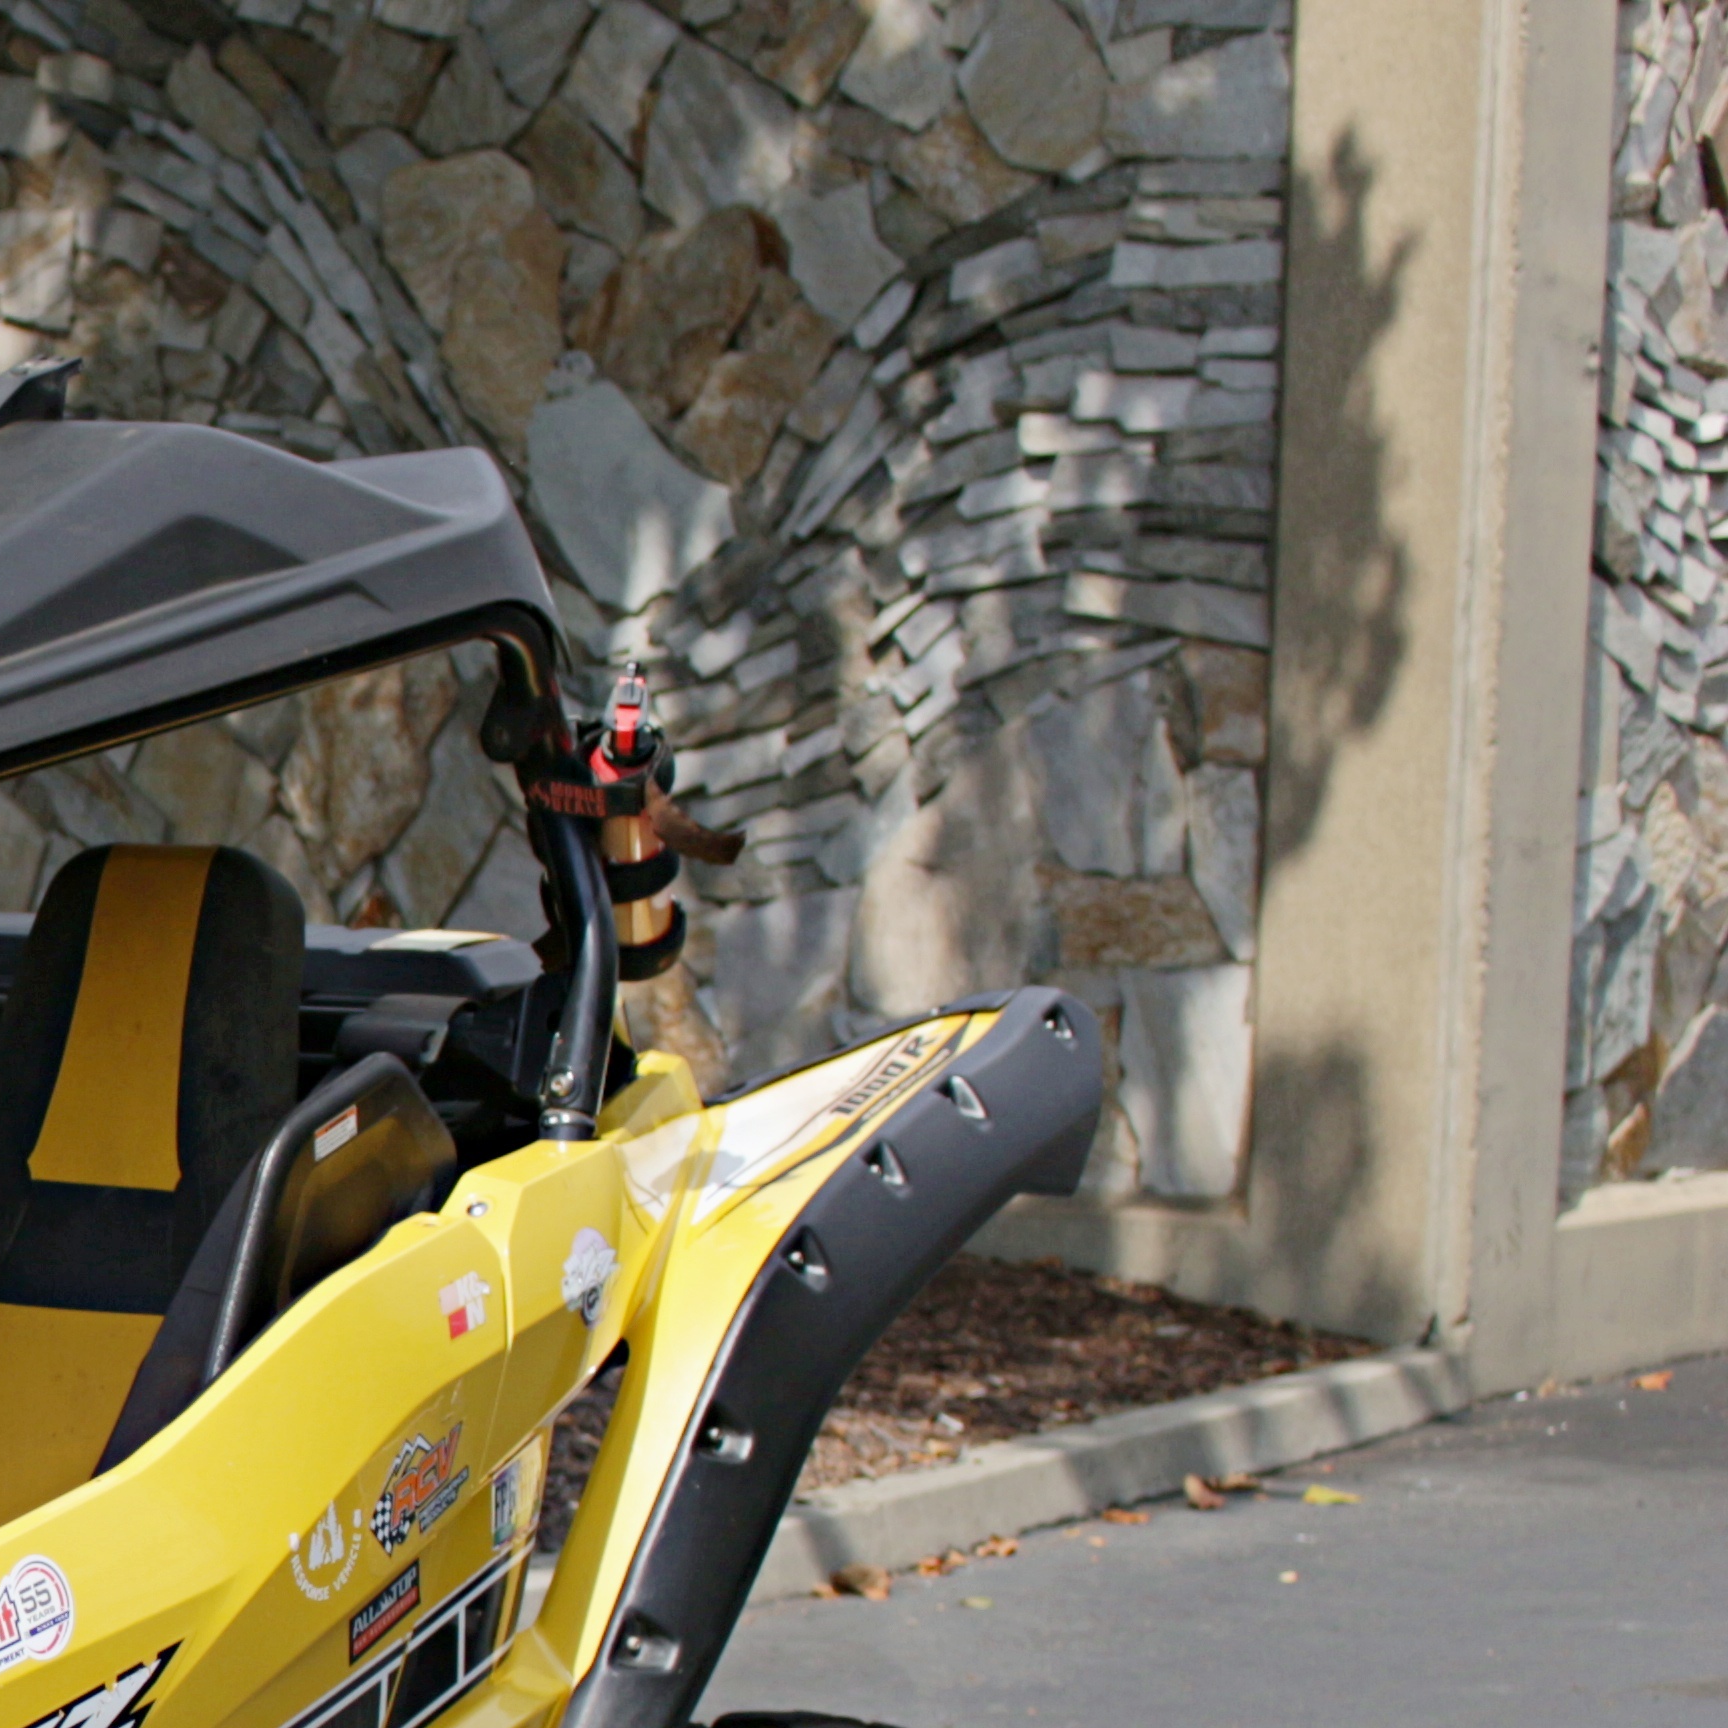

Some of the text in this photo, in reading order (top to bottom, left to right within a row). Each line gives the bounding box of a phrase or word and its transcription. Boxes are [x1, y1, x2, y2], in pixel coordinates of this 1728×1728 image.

[290, 1533, 362, 1602] RESPONSE VEHICLE
[19, 1579, 52, 1614] 55
[27, 1605, 56, 1625] YEARS
